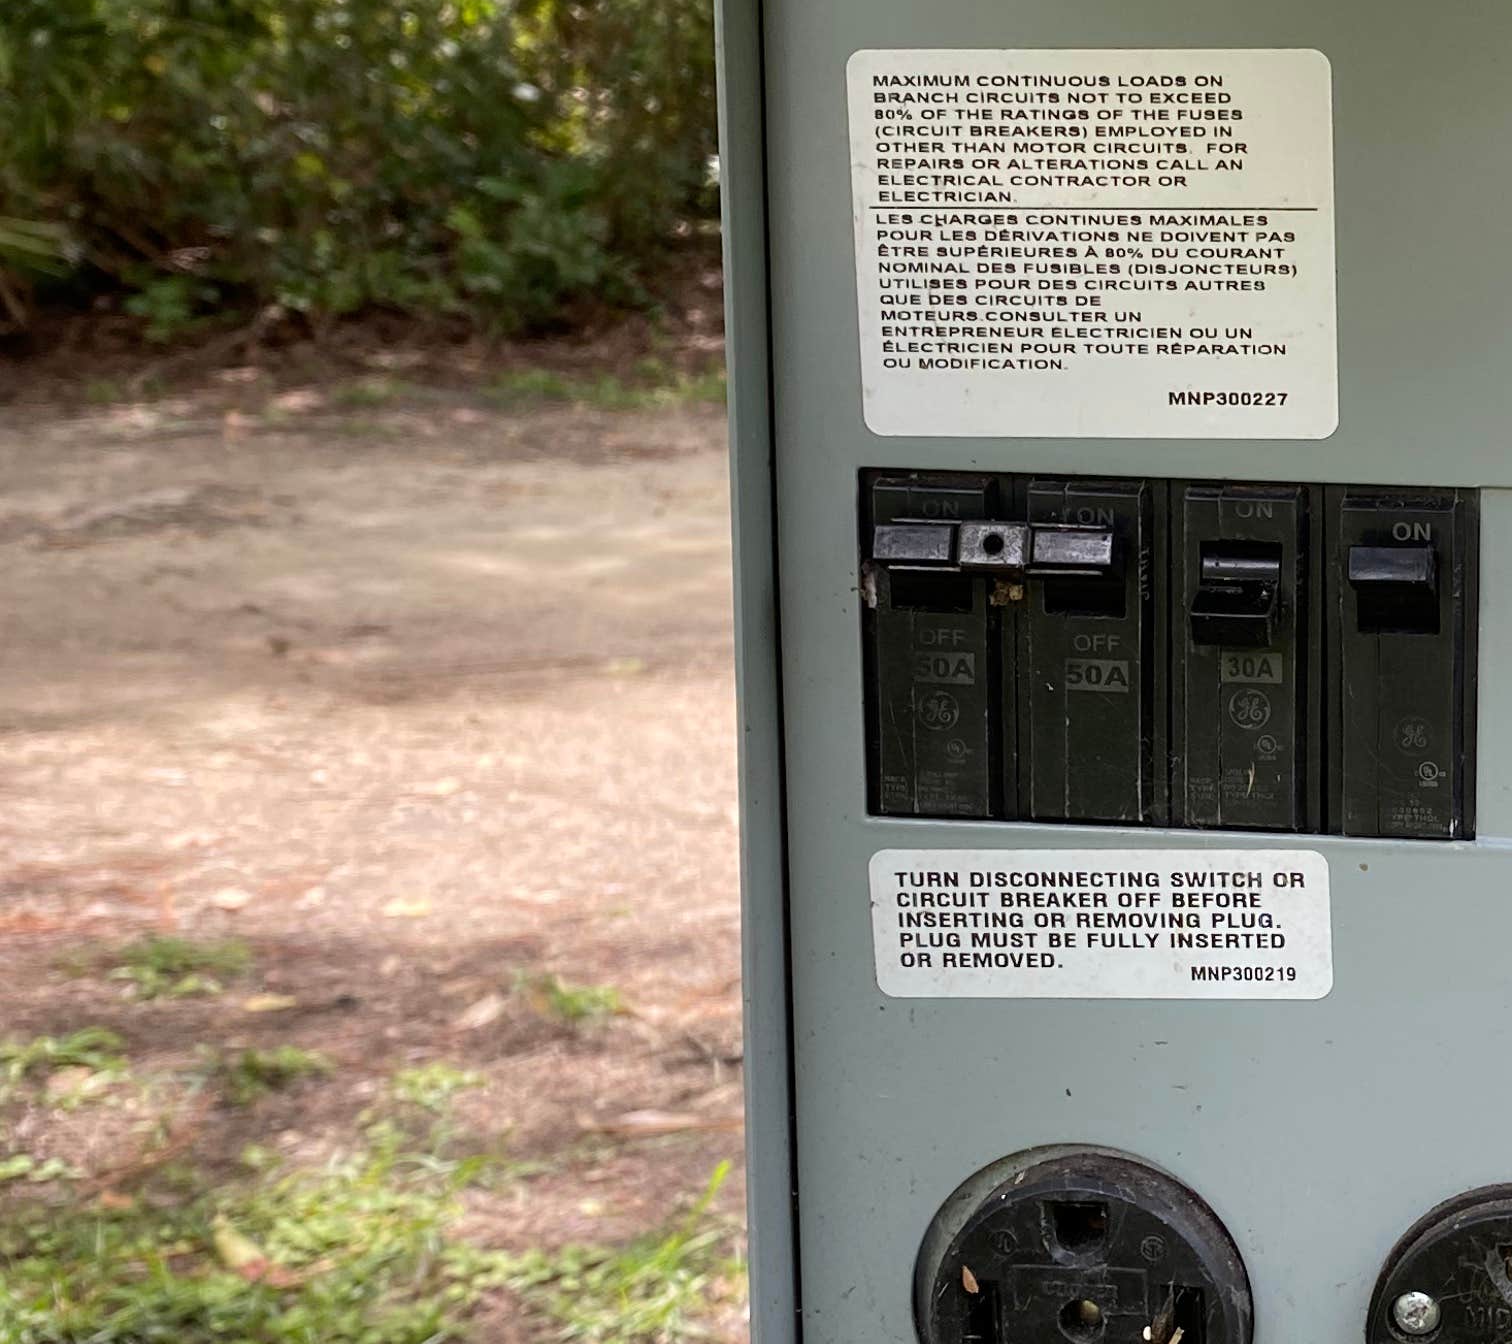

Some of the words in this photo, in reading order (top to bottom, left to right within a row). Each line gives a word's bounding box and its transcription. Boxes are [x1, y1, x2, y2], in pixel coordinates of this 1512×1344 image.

[873, 75, 970, 87] MAXIMUM
[977, 75, 1110, 87] CONTINUOUS
[1118, 76, 1186, 87] LOADS
[1194, 75, 1222, 87] ON
[874, 92, 958, 106] BRANCH
[966, 91, 1060, 104] CIRCUITS
[1068, 92, 1109, 104] NOT
[1116, 93, 1142, 104] TO
[1150, 92, 1231, 104] EXCEED
[874, 109, 912, 120] 80%
[921, 109, 947, 120] OF
[954, 108, 993, 120] THE
[1001, 109, 1089, 120] RATINGS
[1097, 109, 1123, 120] OF
[1131, 109, 1170, 120] THE
[1177, 109, 1243, 120] FUSES
[875, 125, 963, 139] (CIRCUIT
[970, 125, 1087, 139] BREAKERS)
[1095, 126, 1206, 137] EMPLOYED
[1214, 126, 1232, 137] IN
[876, 142, 945, 153] OTHER
[952, 142, 1005, 153] THAN
[1013, 142, 1086, 153] MOTOR
[1093, 143, 1192, 154] CIRCUITS.
[1207, 143, 1247, 154] FOR
[877, 158, 964, 169] REPAIRS
[972, 159, 1001, 170] OR
[1007, 159, 1148, 170] ALTERATIONS
[1156, 159, 1208, 170] CALL
[1215, 159, 1242, 170] AN
[878, 175, 1003, 186] ELECTRICAL
[1010, 175, 1151, 187] CONTRACTOR
[1158, 176, 1187, 187] OR
[879, 191, 1017, 203] ELECTRICIAN.
[876, 214, 913, 224] LES
[918, 214, 1018, 228] CHARGES
[1026, 215, 1142, 226] CONTINUES
[1150, 215, 1268, 226] MAXIMALES
[877, 230, 933, 241] POUR
[940, 230, 977, 241] LES
[985, 229, 1119, 242] DÉRIVATIONS
[1127, 231, 1153, 242] NE
[1161, 231, 1249, 242] DOIVENT
[1256, 232, 1295, 242] PAS
[878, 244, 929, 257] ÊTRE
[936, 244, 1077, 258] SUPÉRIEURES
[1105, 248, 1143, 258] 80%
[1152, 248, 1178, 258] DU
[1186, 248, 1285, 259] COURANT
[879, 262, 970, 273] NOMINAL
[977, 262, 1016, 273] DES
[1024, 263, 1120, 274] FUSIBLES
[1128, 264, 1297, 278] (DISJONCTEURS)
[879, 278, 968, 290] UTILISES
[975, 279, 1031, 290] POUR
[1038, 280, 1077, 290] DES
[1084, 280, 1177, 291] CIRCUITS
[1184, 280, 1265, 291] AUTRES
[880, 294, 921, 305] QUE
[929, 292, 968, 305] DES
[975, 295, 1068, 307] CIRCUITS
[1075, 296, 1101, 306] DE
[1115, 312, 1141, 322] UN
[882, 326, 1044, 338] ENTREPRENEUR
[1190, 328, 1217, 339] OU
[1225, 328, 1252, 339] UN
[883, 340, 1013, 354] ÉLECTRICIEN
[1021, 343, 1076, 354] POUR
[1083, 344, 1149, 354] TOUTE
[1157, 342, 1286, 355] RÉPARATION
[883, 358, 910, 368] OU
[919, 358, 1067, 369] MODIFICATION.
[1169, 392, 1288, 406] MNP300227
[920, 499, 960, 517] ON
[1234, 502, 1274, 520] ON
[1077, 506, 1115, 526] ON
[1392, 522, 1432, 541] ON
[919, 627, 968, 646] OFF
[1071, 633, 1121, 653] OFF
[916, 654, 974, 680] 50A
[1227, 657, 1274, 678] 30A
[1066, 663, 1128, 688] 50A
[894, 872, 959, 887] TURN
[970, 872, 1159, 887] DISCONNECTING
[1171, 872, 1262, 888] SWITCH
[1273, 872, 1305, 888] OR
[897, 892, 990, 908] CIRCUIT
[1000, 892, 1108, 908] BREAKER
[1118, 892, 1160, 908] OFF
[1172, 892, 1262, 908] BEFORE
[898, 910, 1024, 928] INSERTING
[1034, 912, 1065, 928] OR
[1076, 913, 1200, 928] REMOVING
[1212, 913, 1281, 928] PLUG.
[900, 933, 961, 948] PLUG
[971, 933, 1038, 948] MUST
[1049, 933, 1076, 948] BE
[1087, 933, 1159, 948] FULLY
[1170, 933, 1285, 948] INSERTED
[900, 952, 932, 967] OR
[942, 952, 1063, 968] REMOVED.
[1191, 966, 1296, 981] MNP300219
